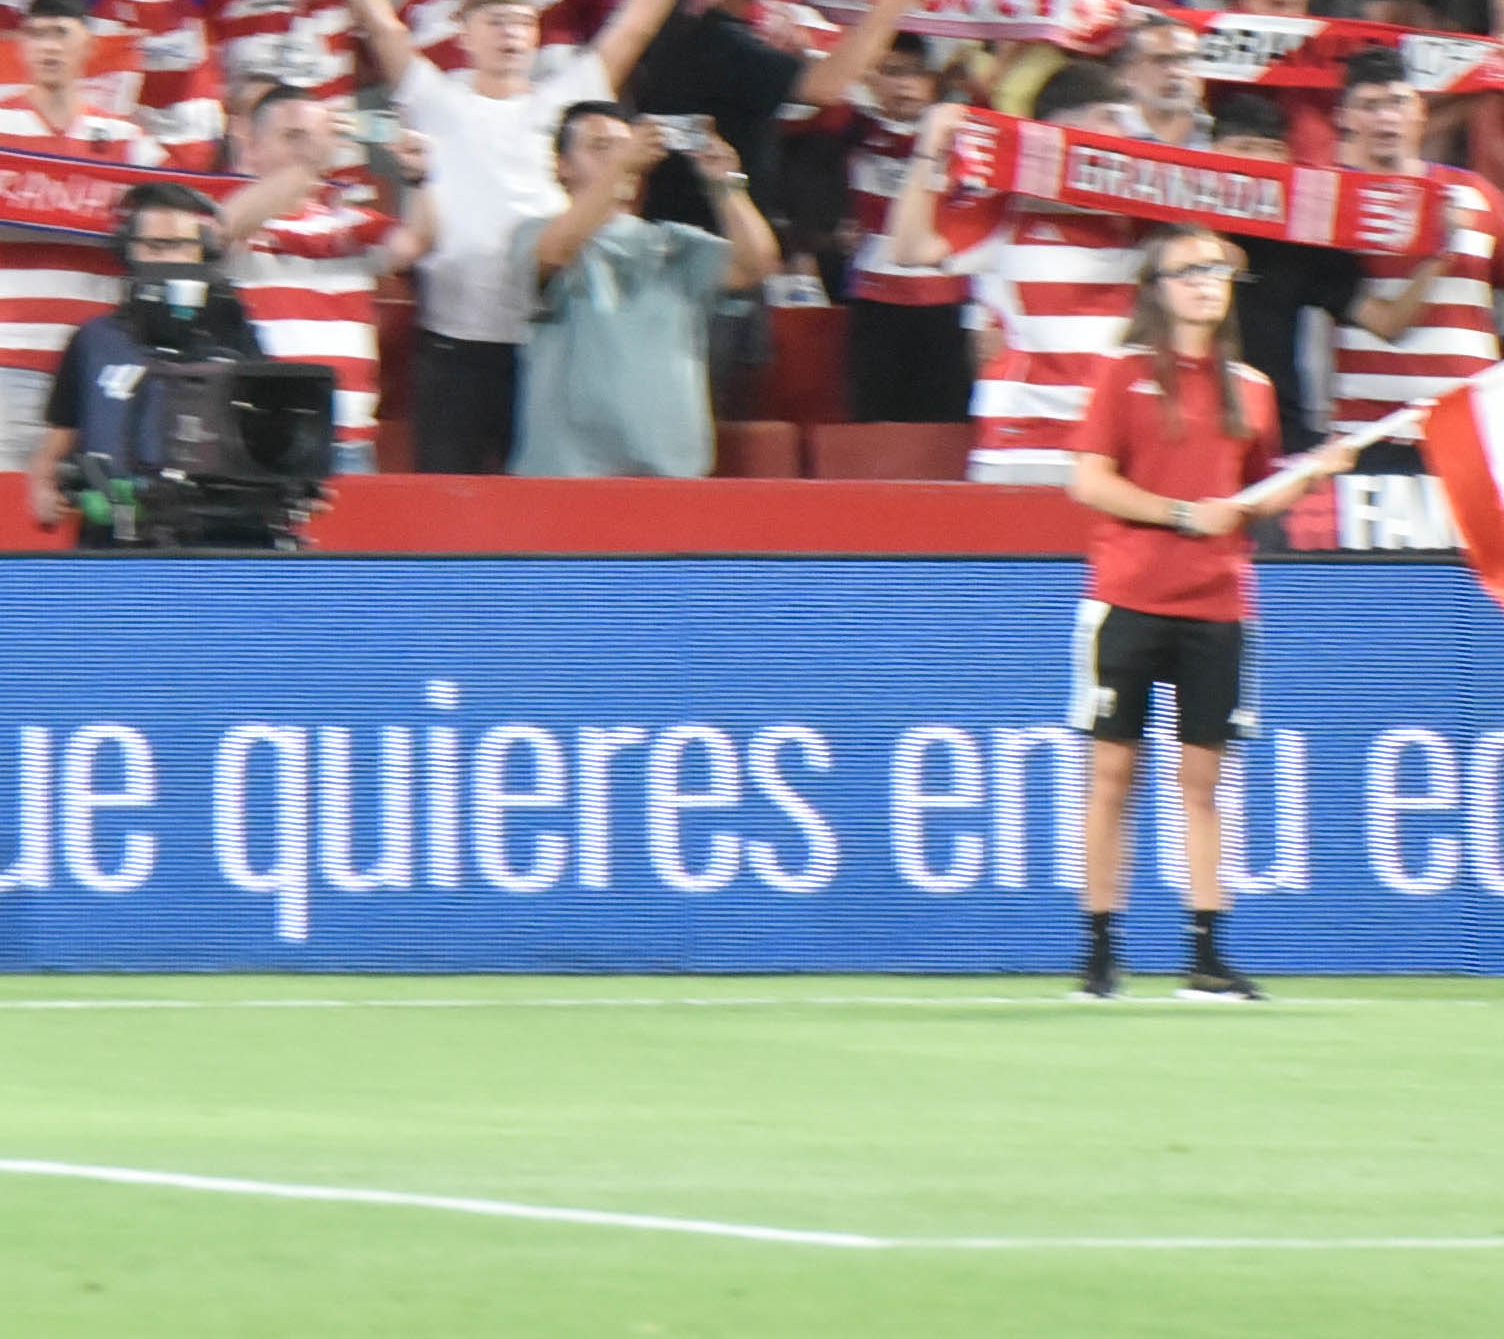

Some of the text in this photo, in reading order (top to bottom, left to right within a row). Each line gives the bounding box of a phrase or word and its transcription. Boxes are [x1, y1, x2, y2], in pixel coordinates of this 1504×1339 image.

[1065, 142, 1290, 228] GRANADA
[212, 678, 838, 941] quieres
[890, 725, 1088, 893] en
